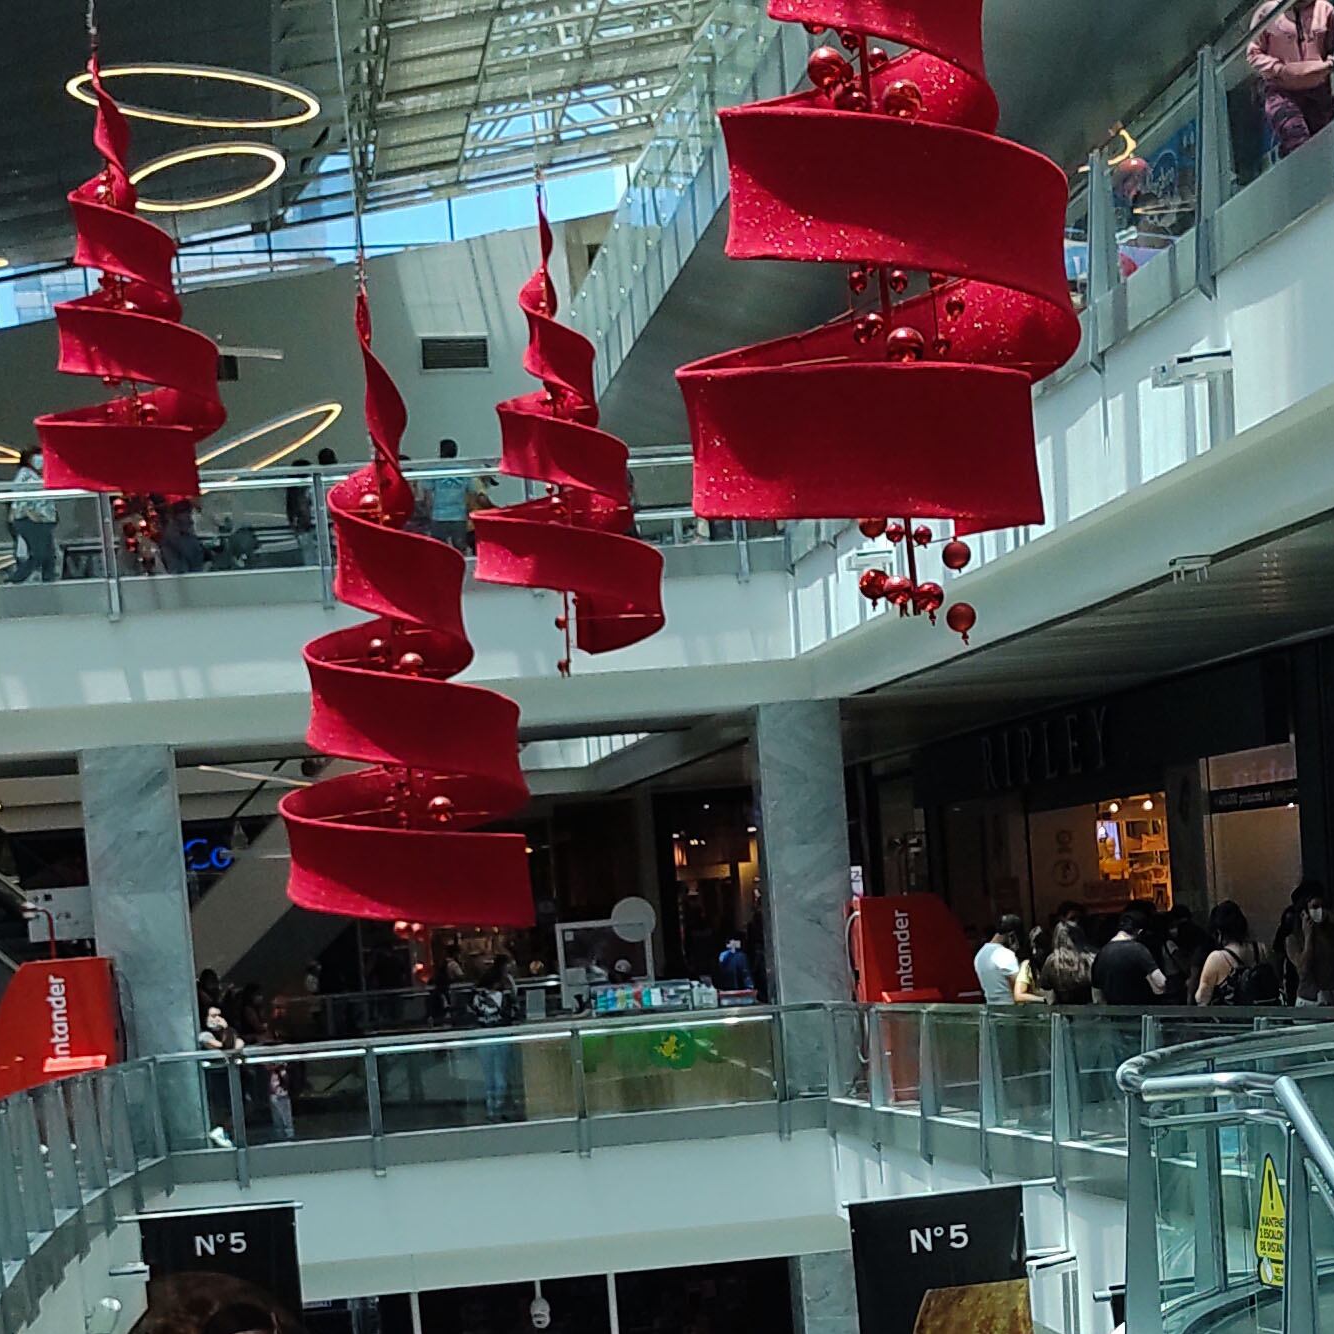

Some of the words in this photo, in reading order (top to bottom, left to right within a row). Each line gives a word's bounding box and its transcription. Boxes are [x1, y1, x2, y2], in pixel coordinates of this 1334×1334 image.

[980, 705, 1108, 791] RIPLEY
[893, 909, 914, 992] ntander
[46, 974, 71, 1056] ntander
